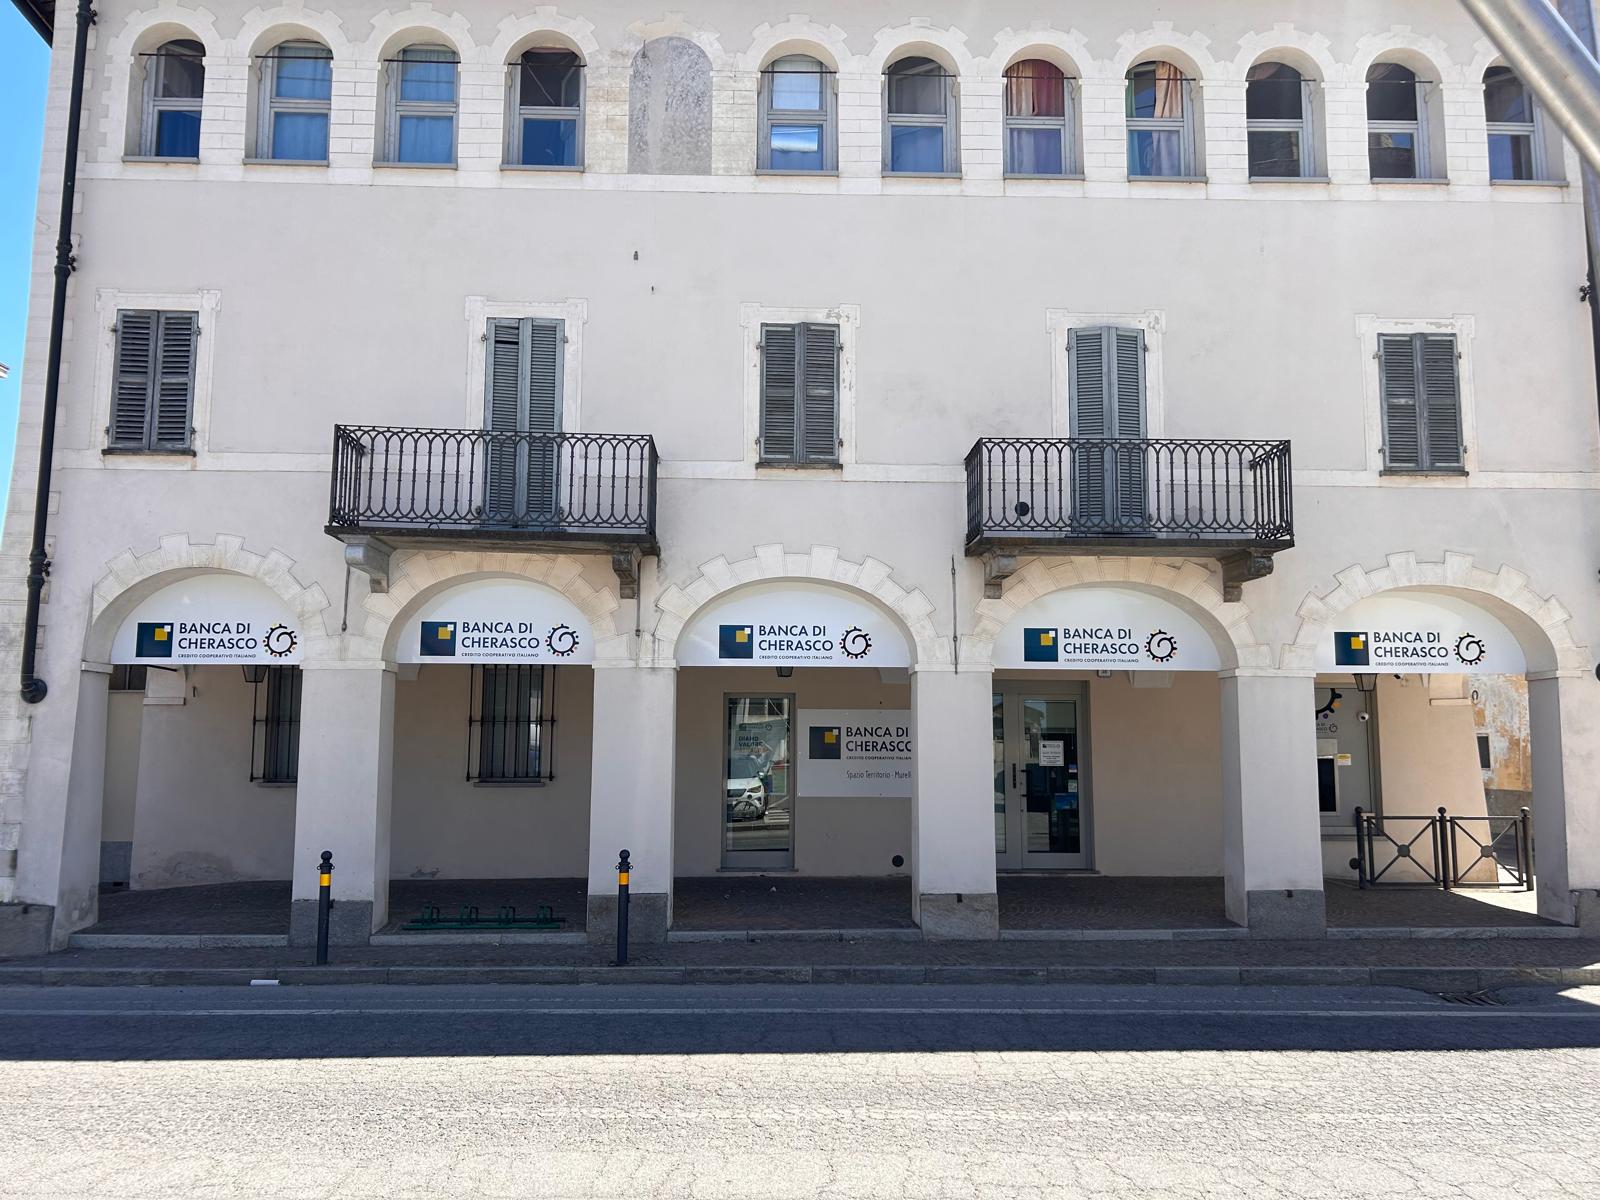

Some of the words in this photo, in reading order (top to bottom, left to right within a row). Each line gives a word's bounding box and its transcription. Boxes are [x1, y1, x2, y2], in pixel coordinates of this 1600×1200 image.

[179, 622, 232, 634] BANCA
[236, 622, 250, 634] DI
[462, 622, 514, 634] BANCA
[519, 622, 532, 634] DI
[759, 625, 808, 636] BANCA
[812, 626, 826, 636] DI
[1064, 628, 1114, 640] BANCA
[1118, 628, 1132, 640] DI
[1374, 632, 1423, 643] BANCA
[1427, 632, 1440, 643] DI
[178, 638, 258, 650] CHERASCO
[462, 637, 540, 648] CHERASCO
[759, 640, 834, 651] CHERASCO
[1064, 643, 1139, 654] CHERASCO
[1374, 646, 1448, 658] CHERASCO
[846, 727, 892, 737] BANCA
[896, 727, 908, 737] DI
[846, 770, 864, 780] Spazio
[866, 770, 890, 778] Territorio
